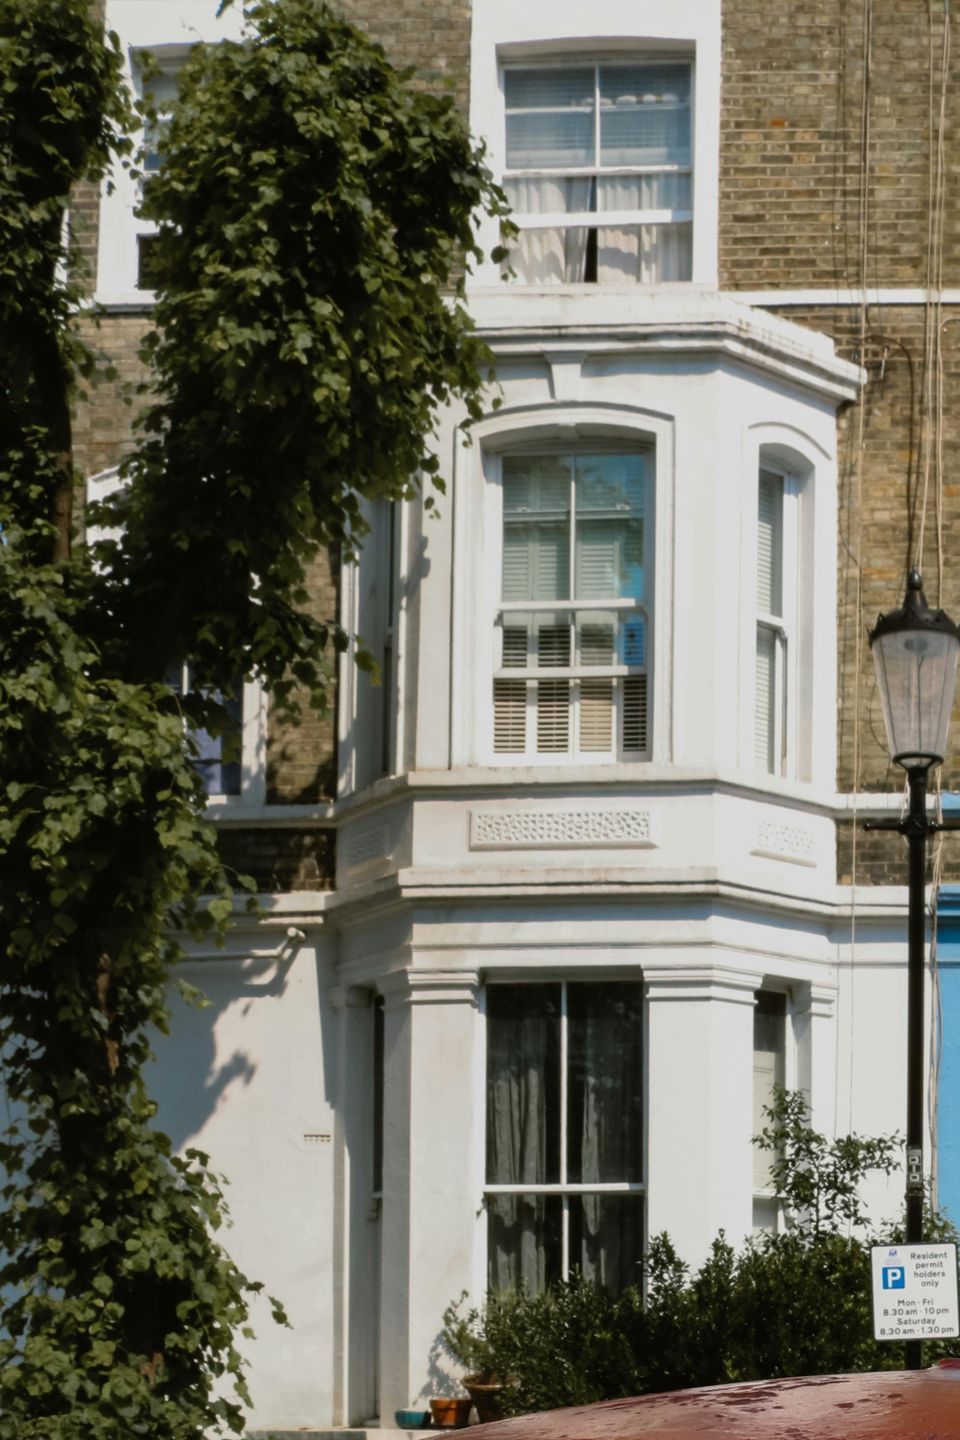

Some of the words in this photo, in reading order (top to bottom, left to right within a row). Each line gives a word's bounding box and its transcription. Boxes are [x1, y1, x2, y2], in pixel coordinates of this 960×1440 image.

[910, 1252, 948, 1260] Resident
[887, 1268, 901, 1288] P
[883, 1308, 904, 1316] 8.30
[924, 1307, 935, 1315] 10
[897, 1317, 936, 1326] Saturday
[880, 1328, 901, 1336] 8.30
[921, 1326, 940, 1334] 1.30
